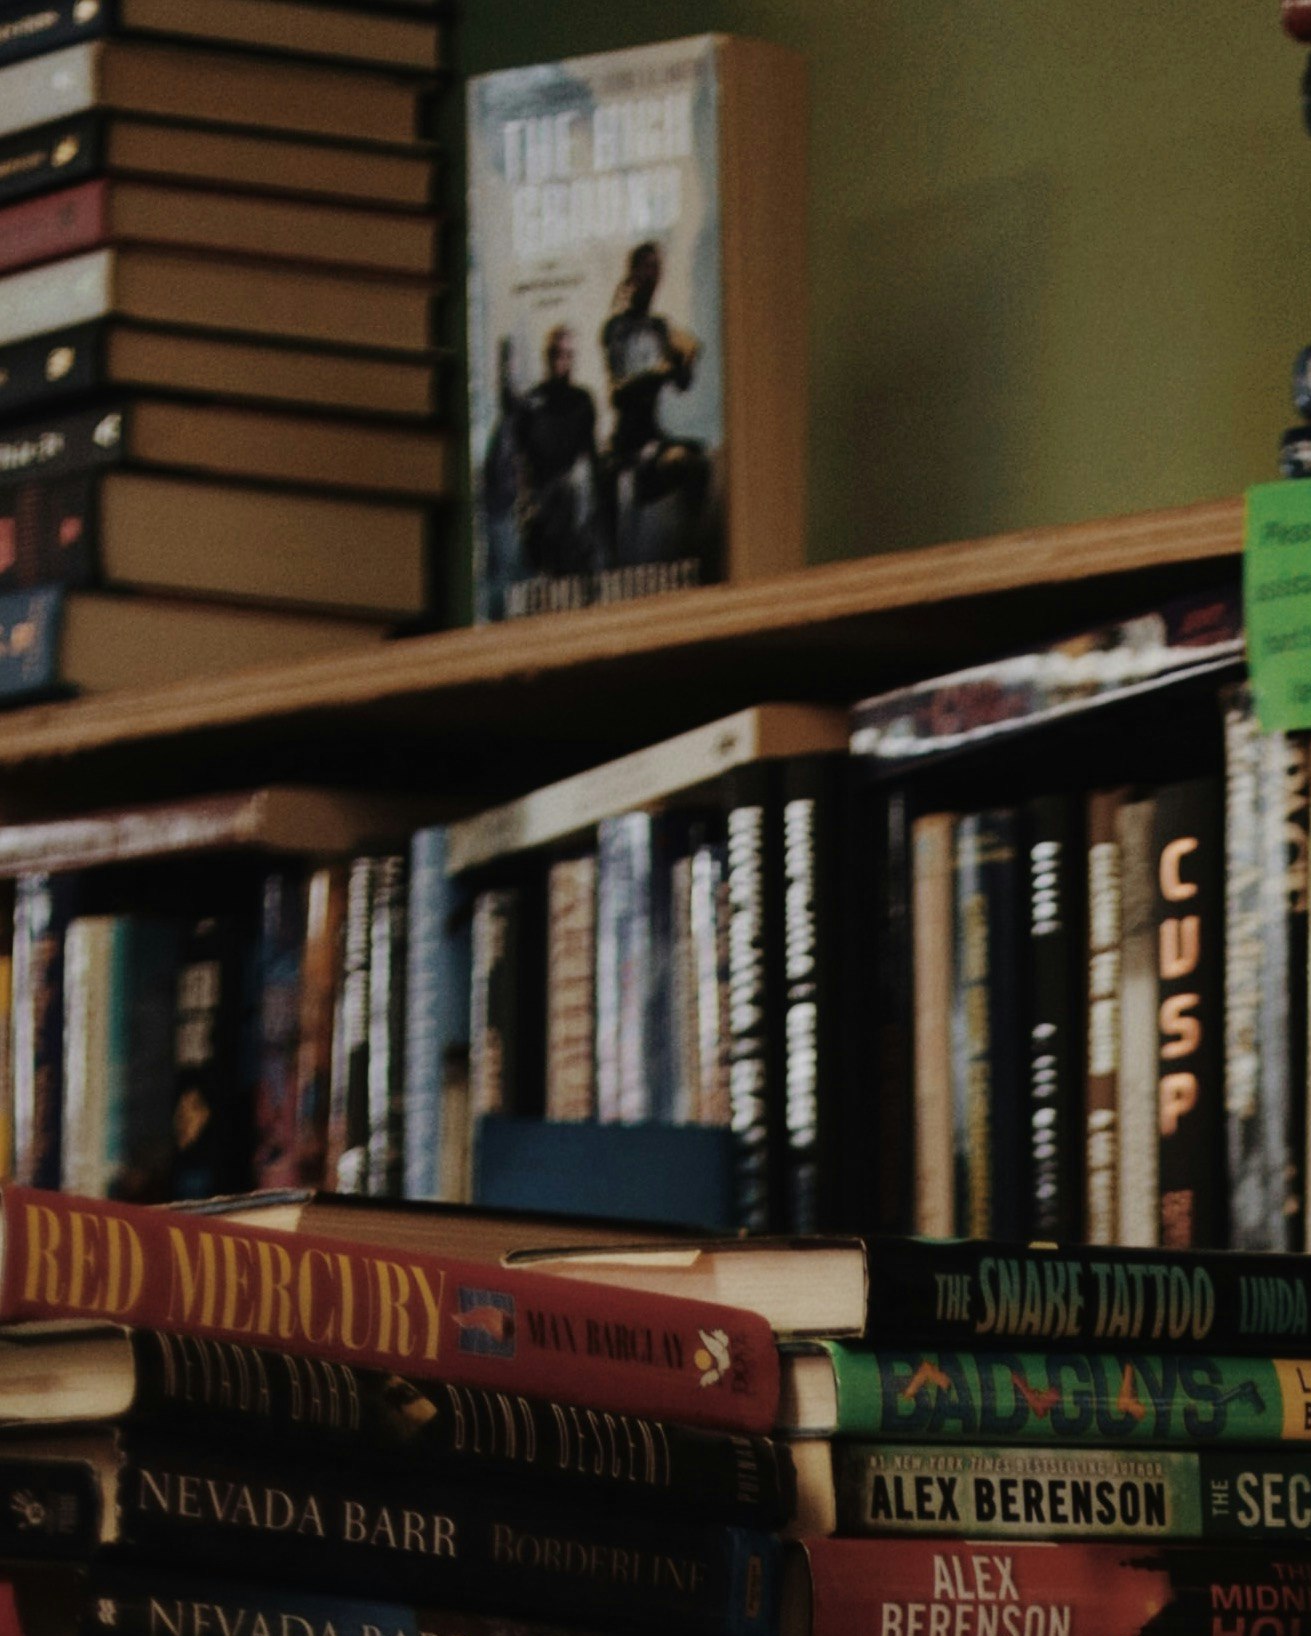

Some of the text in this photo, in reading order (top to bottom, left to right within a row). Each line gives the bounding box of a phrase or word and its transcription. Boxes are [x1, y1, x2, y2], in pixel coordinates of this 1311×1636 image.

[1158, 836, 1201, 1135] CUSP
[23, 1204, 448, 1360] RED MERCURY
[934, 1271, 971, 1322] THE
[975, 1255, 1084, 1342] SNAKE
[1090, 1261, 1216, 1339] TATTOO
[1237, 1275, 1309, 1337] LINDA
[870, 1474, 1167, 1527] ALEX BERENSON
